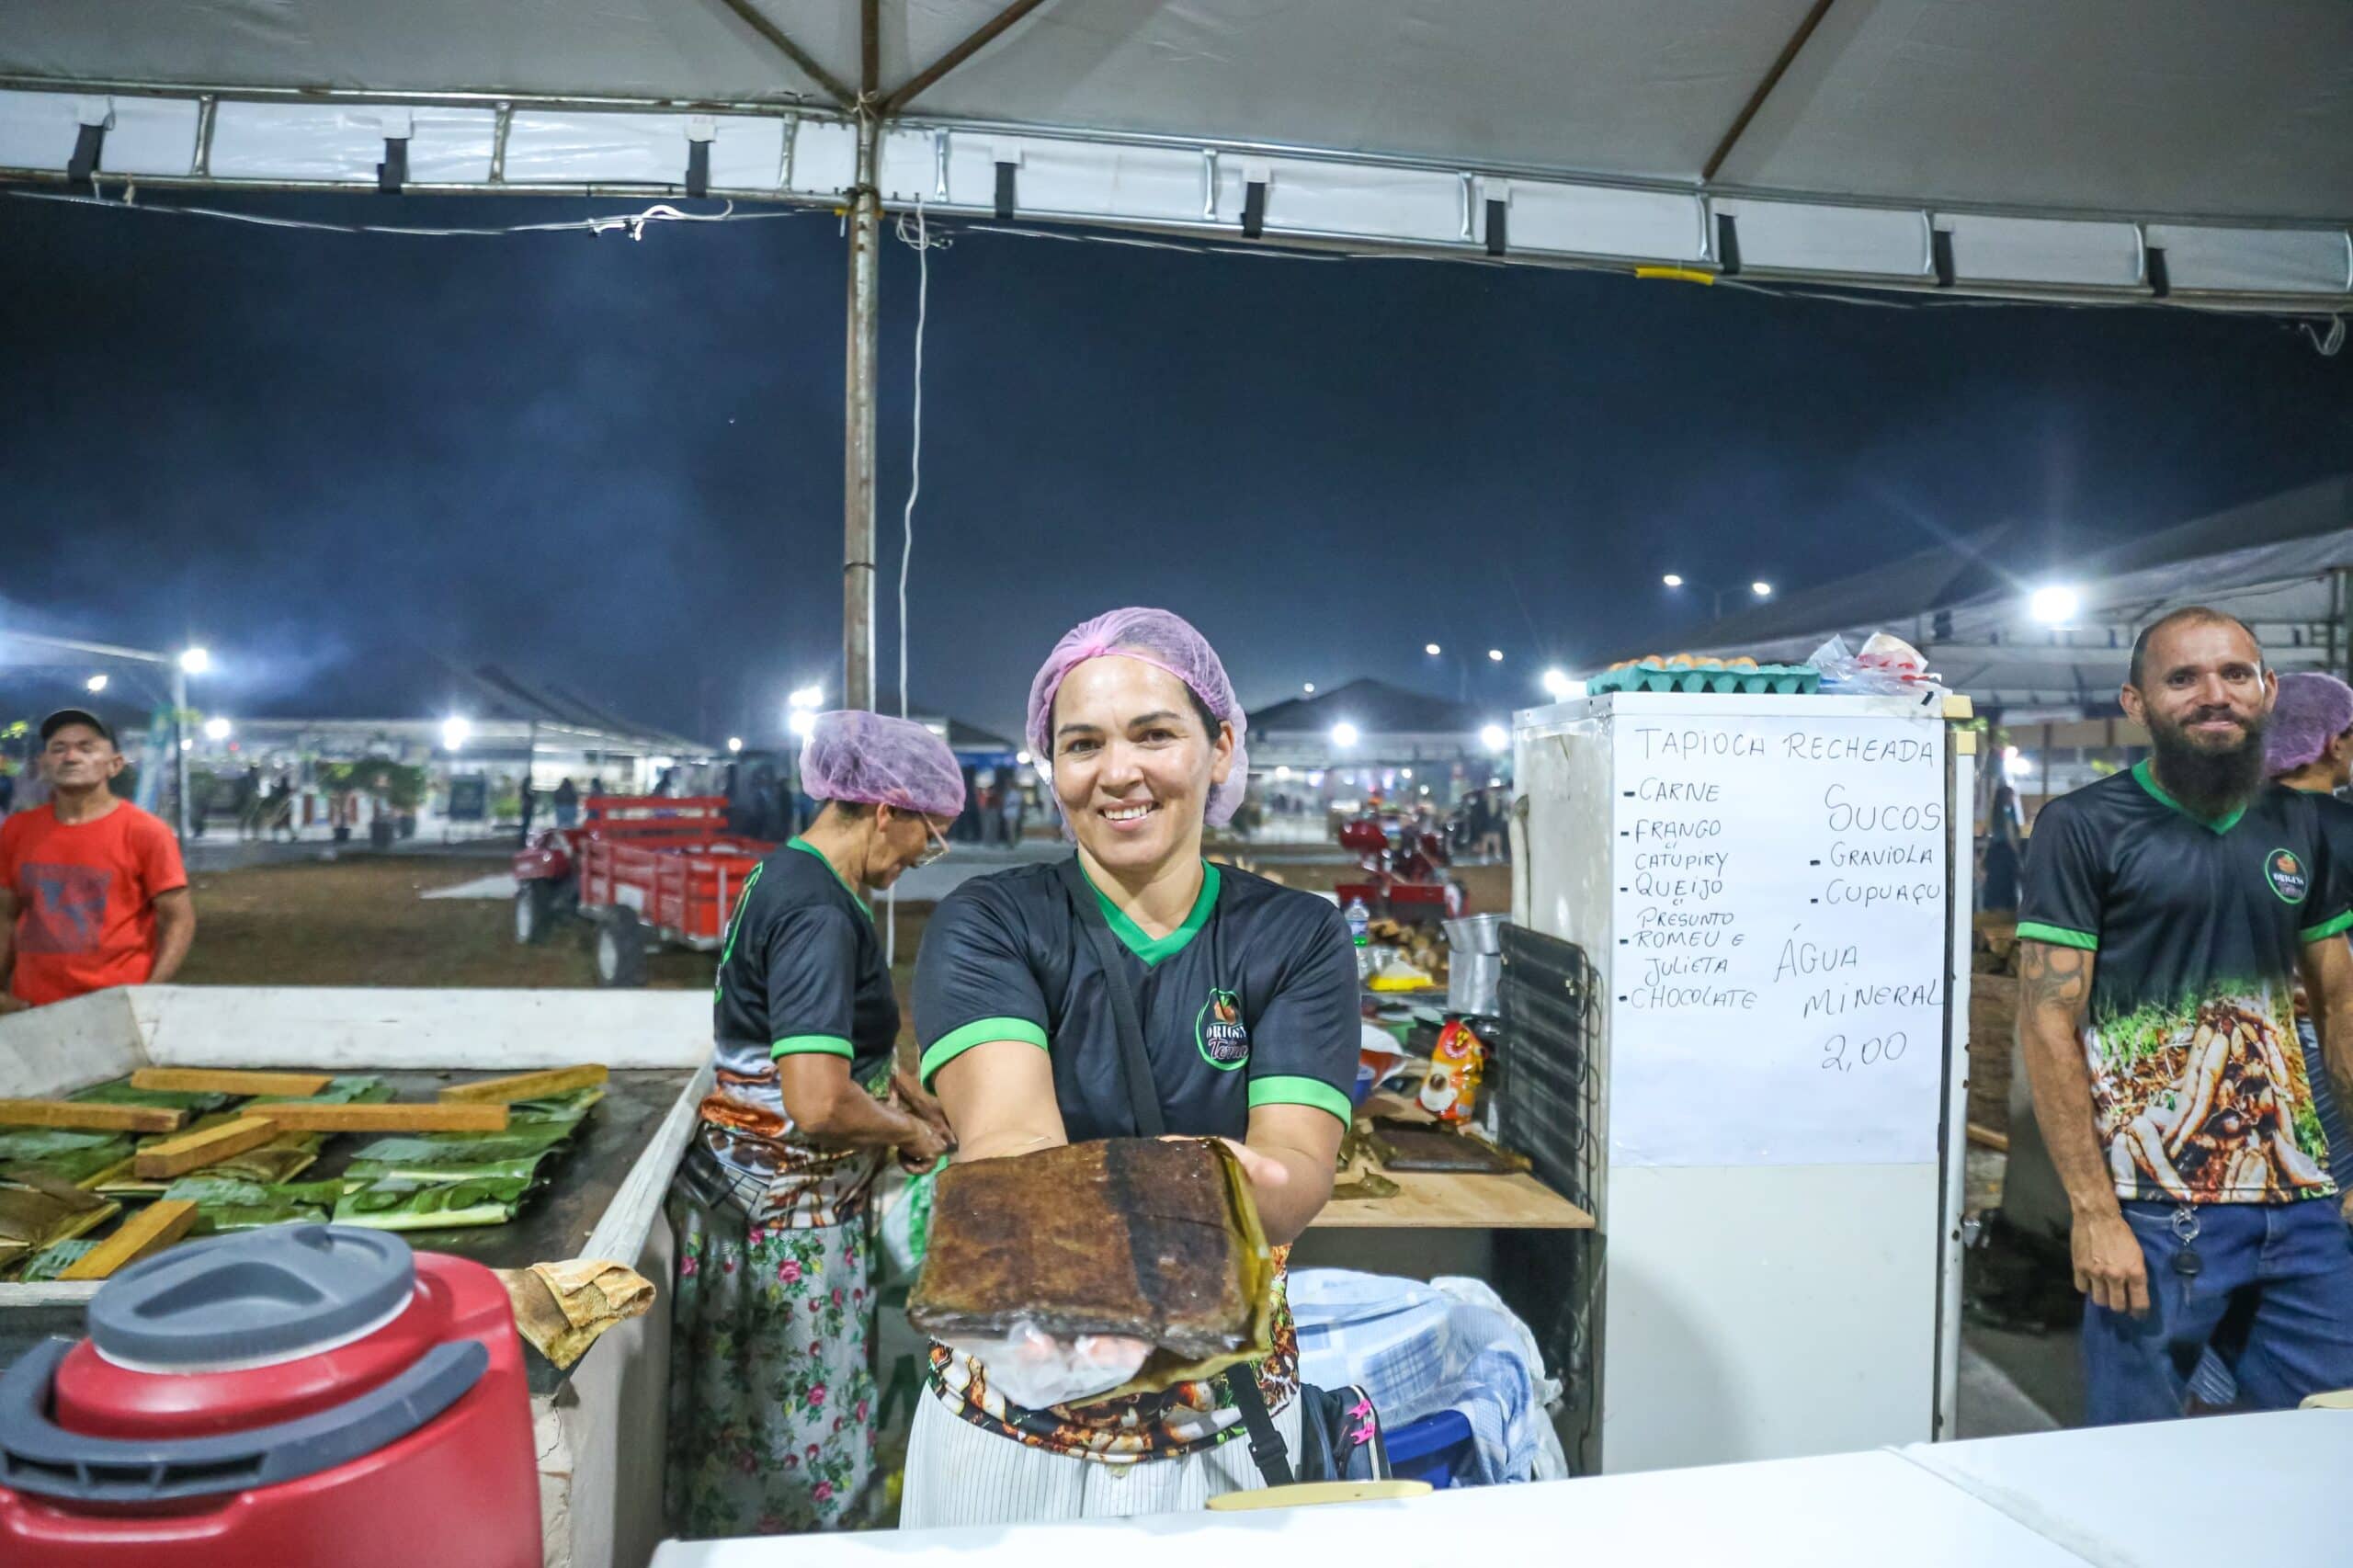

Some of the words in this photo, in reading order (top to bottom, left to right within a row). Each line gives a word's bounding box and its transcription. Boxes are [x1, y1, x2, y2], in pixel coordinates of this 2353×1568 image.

[1782, 732, 1934, 767] RECHEADA
[1639, 777, 1721, 802] CARNE
[1634, 818, 1722, 845] FRANGO
[1634, 851, 1729, 878] CATUPIRY
[1830, 840, 1933, 868] GRAVIOLA
[1634, 871, 1723, 901] QUEIJO
[1636, 906, 1734, 928] PRESUNTO
[1632, 930, 1721, 949] ROMEU
[1773, 923, 1858, 983] ÁGUA
[1644, 956, 1729, 987] JULIETA
[1631, 985, 1758, 1009] CHOCOLATE
[1803, 978, 1944, 1019] MINERAL
[1822, 1031, 1907, 1074] 2,00
